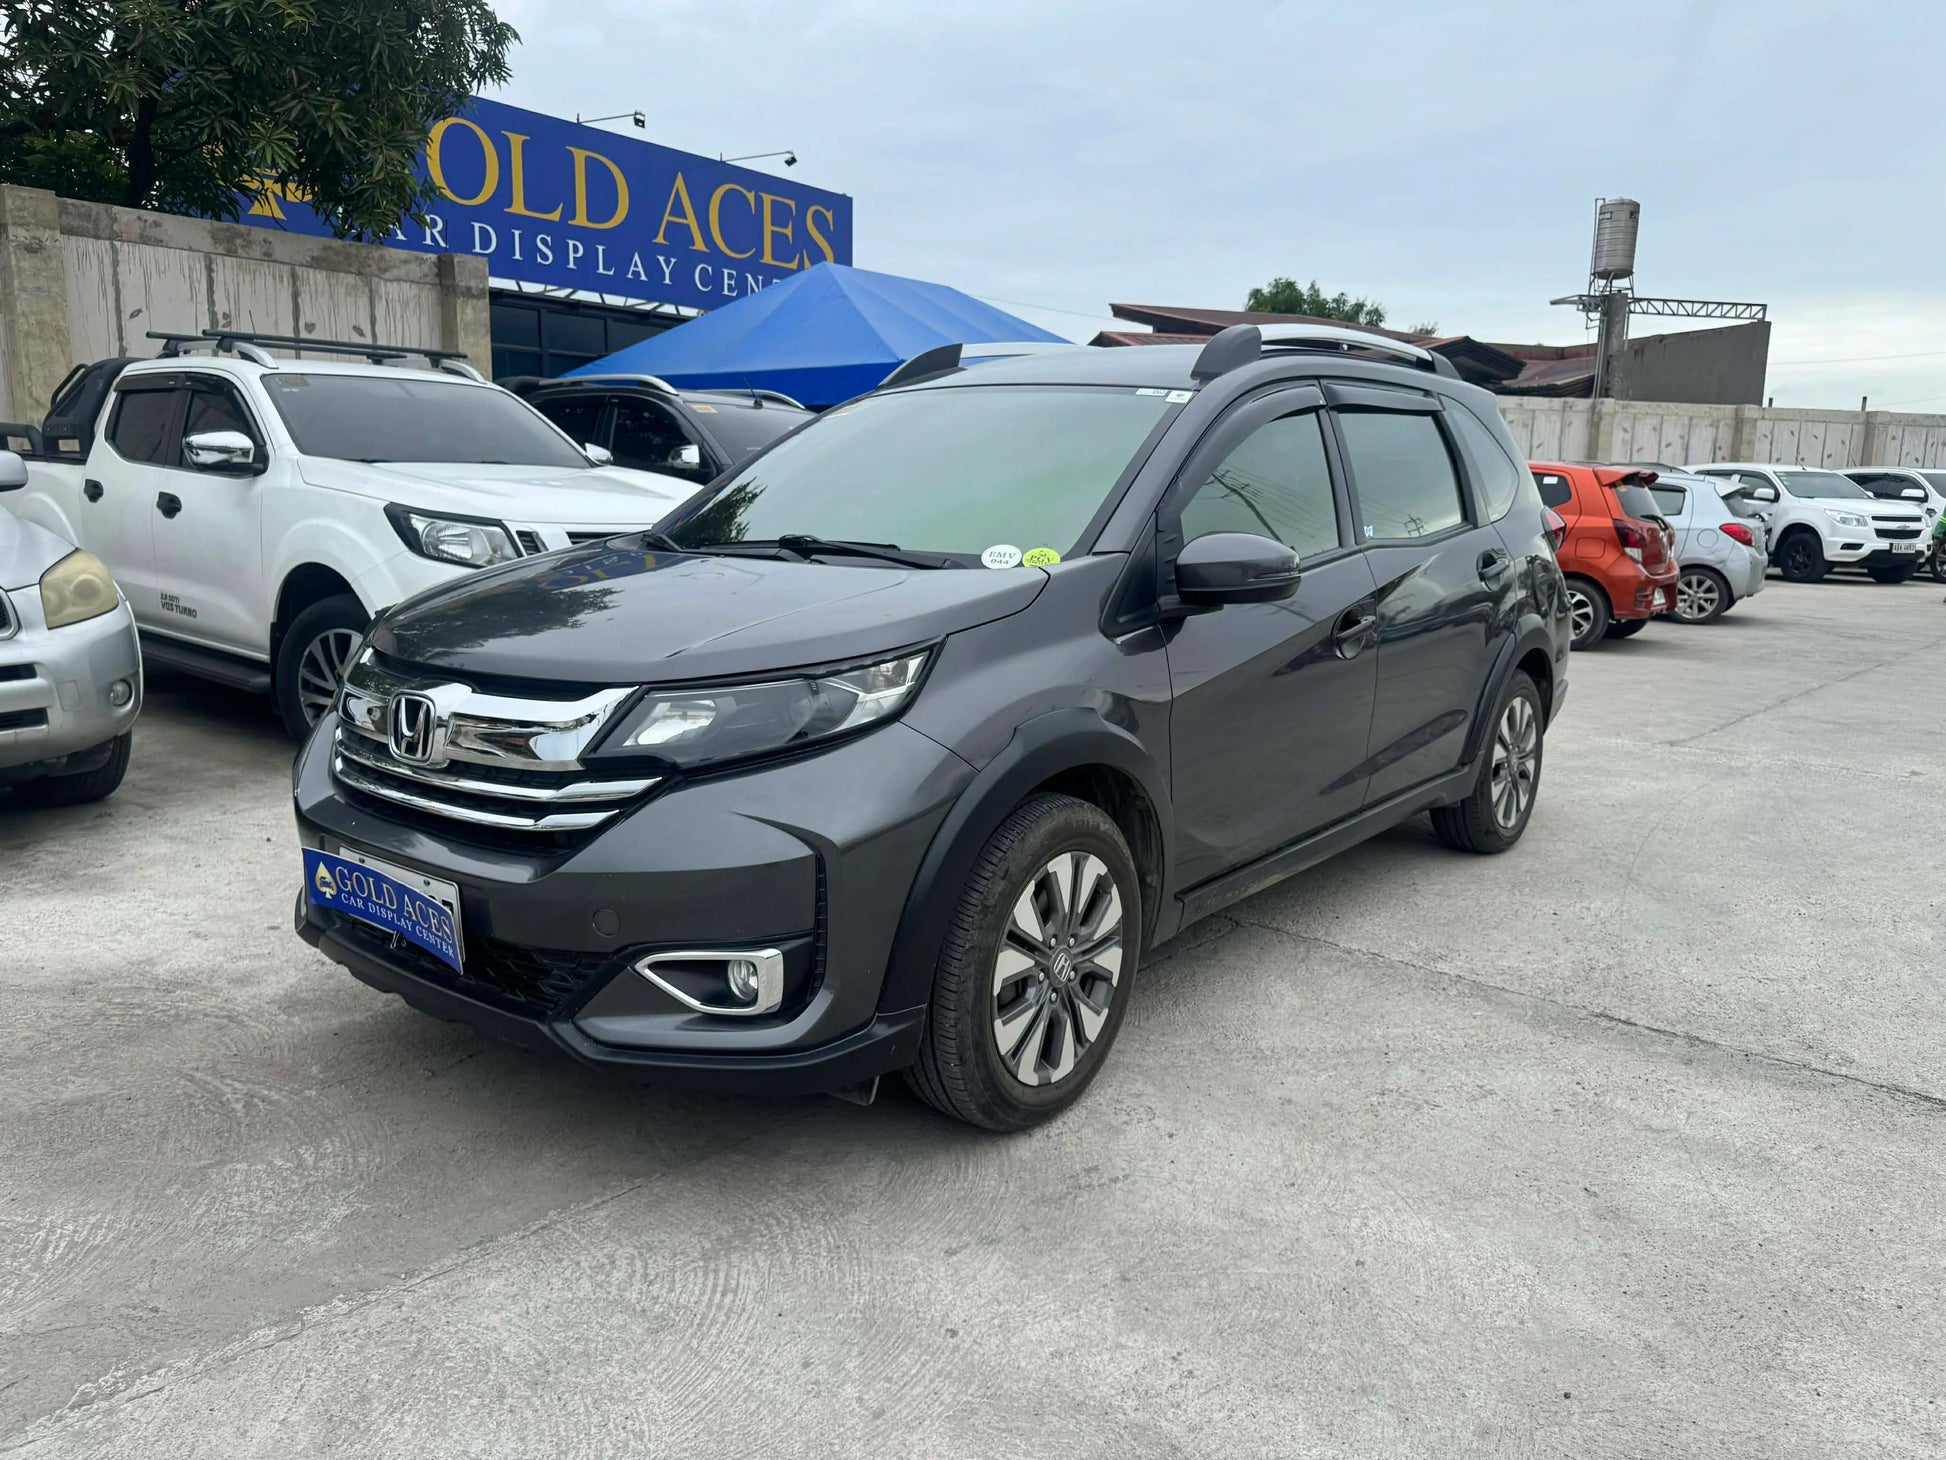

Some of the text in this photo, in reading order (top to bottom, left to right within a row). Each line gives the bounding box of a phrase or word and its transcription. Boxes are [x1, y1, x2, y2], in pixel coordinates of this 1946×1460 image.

[426, 116, 630, 230] OLD
[652, 171, 835, 270] ACES
[471, 221, 677, 285] DISPLAY
[694, 263, 781, 297] CEN
[988, 550, 1016, 559] EMV
[335, 866, 397, 910] GOLD
[403, 894, 453, 944] ACES
[341, 893, 365, 910] CAR
[368, 902, 413, 931] DISPLAY
[415, 925, 455, 958] CENTER
